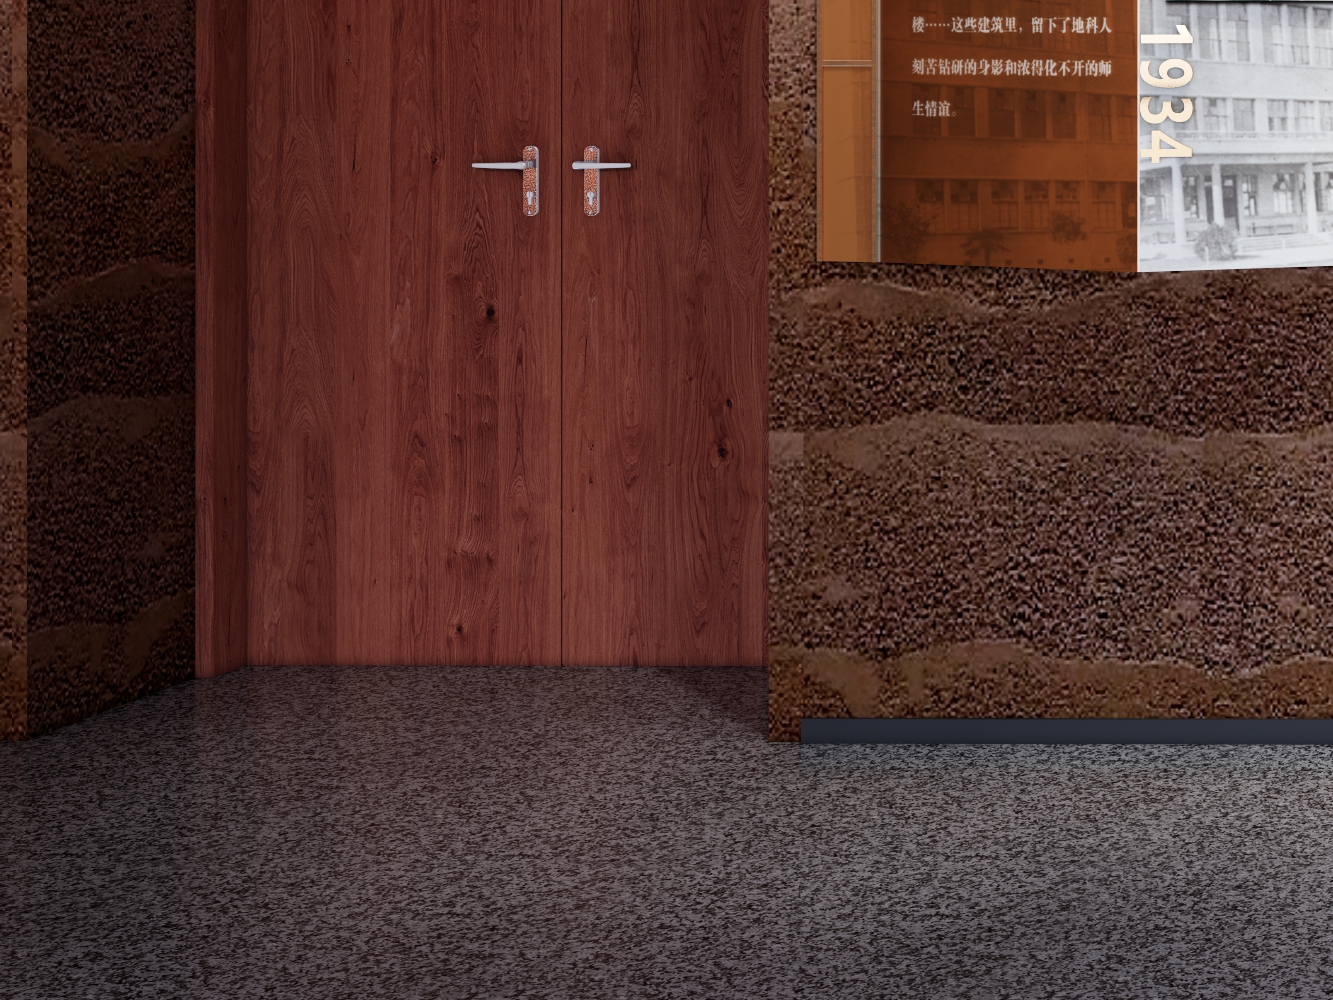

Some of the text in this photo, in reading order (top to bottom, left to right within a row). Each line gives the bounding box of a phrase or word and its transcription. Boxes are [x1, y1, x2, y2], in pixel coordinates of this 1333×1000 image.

[911, 58, 1113, 77] 刻苦钻研的身影和浓得化不开的师
[1140, 24, 1194, 164] 1934
[912, 101, 957, 117] 生情谊。
